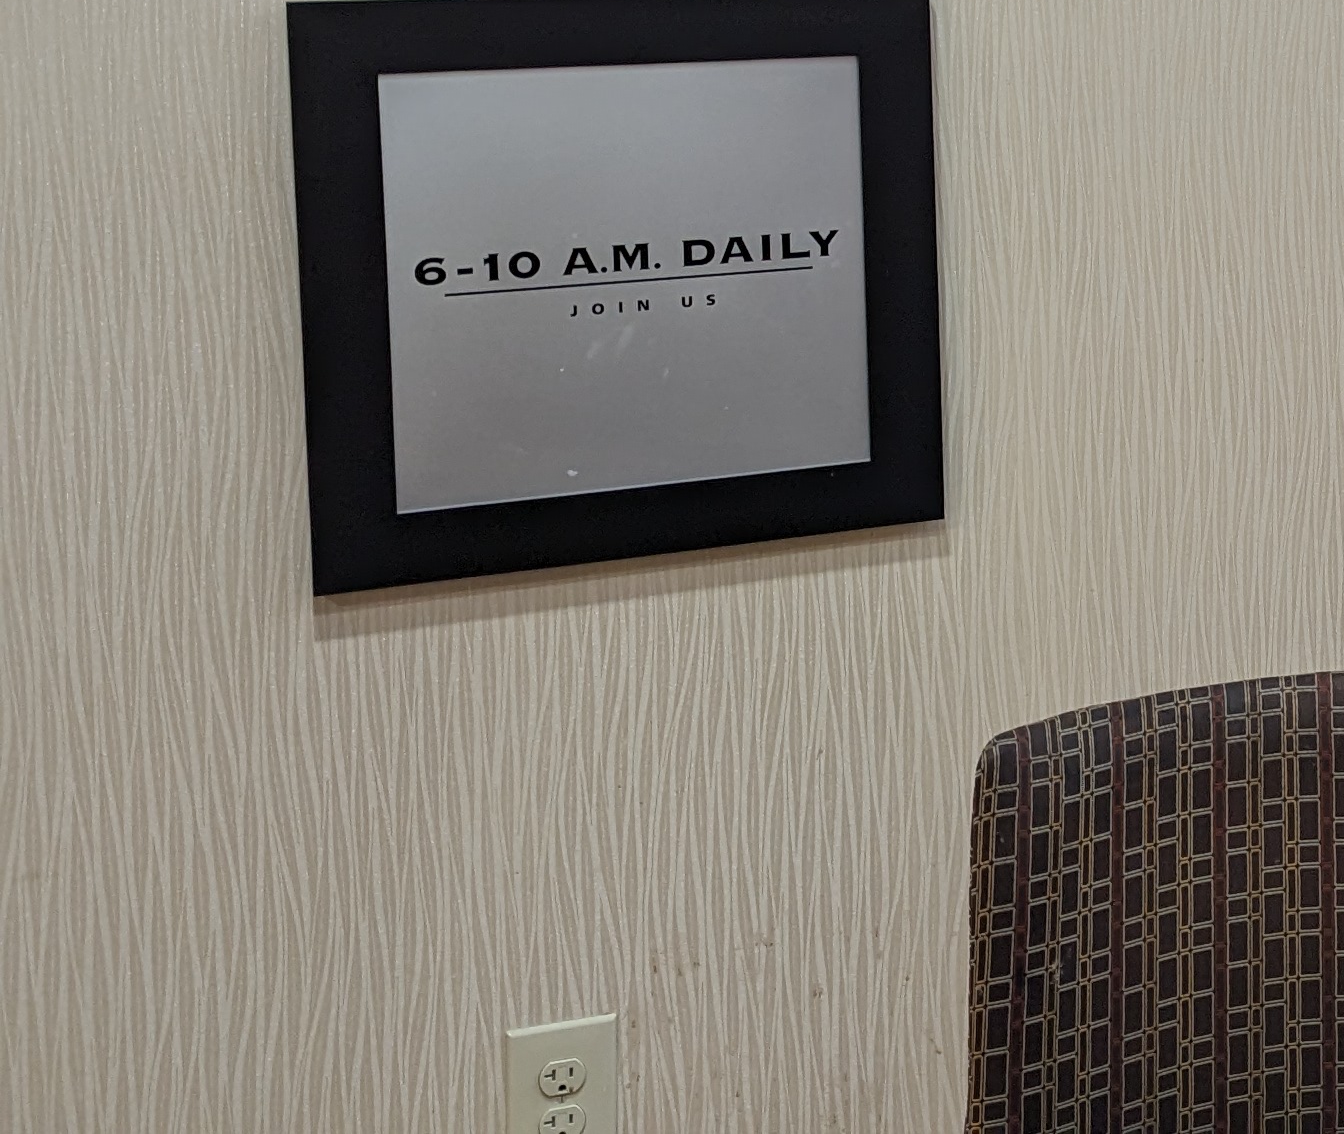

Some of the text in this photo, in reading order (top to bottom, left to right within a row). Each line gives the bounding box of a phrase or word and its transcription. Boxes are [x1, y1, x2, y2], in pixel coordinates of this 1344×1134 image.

[413, 229, 839, 286] 6-10 A.M. DAILY
[570, 294, 717, 318] JOIN US
